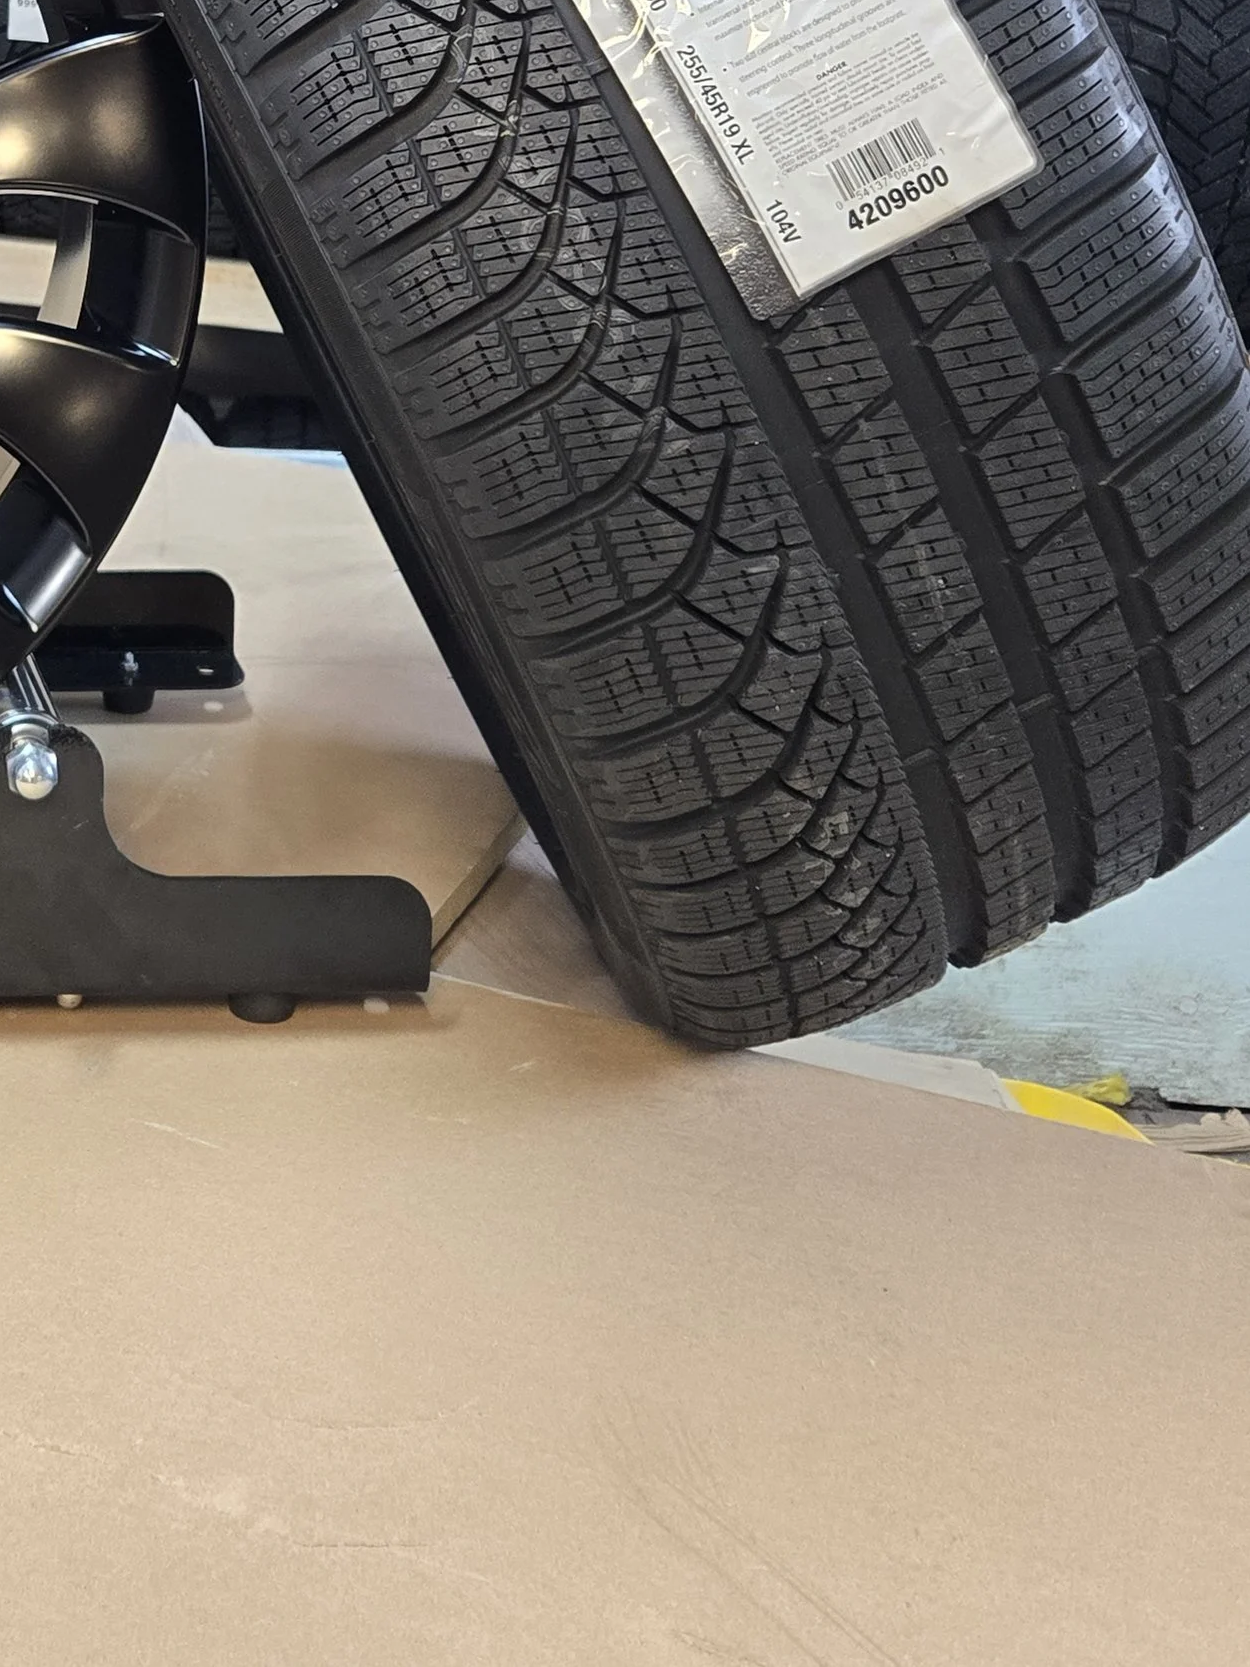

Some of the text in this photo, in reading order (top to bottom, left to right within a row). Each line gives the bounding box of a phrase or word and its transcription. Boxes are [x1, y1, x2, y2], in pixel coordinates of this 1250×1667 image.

[815, 60, 848, 81] DANGER
[675, 40, 743, 142] 255/45R19
[728, 135, 758, 167] XL
[762, 196, 803, 248] 104V
[842, 163, 951, 233] 4209600
[854, 175, 890, 200] 54137
[892, 155, 928, 181] 08492
